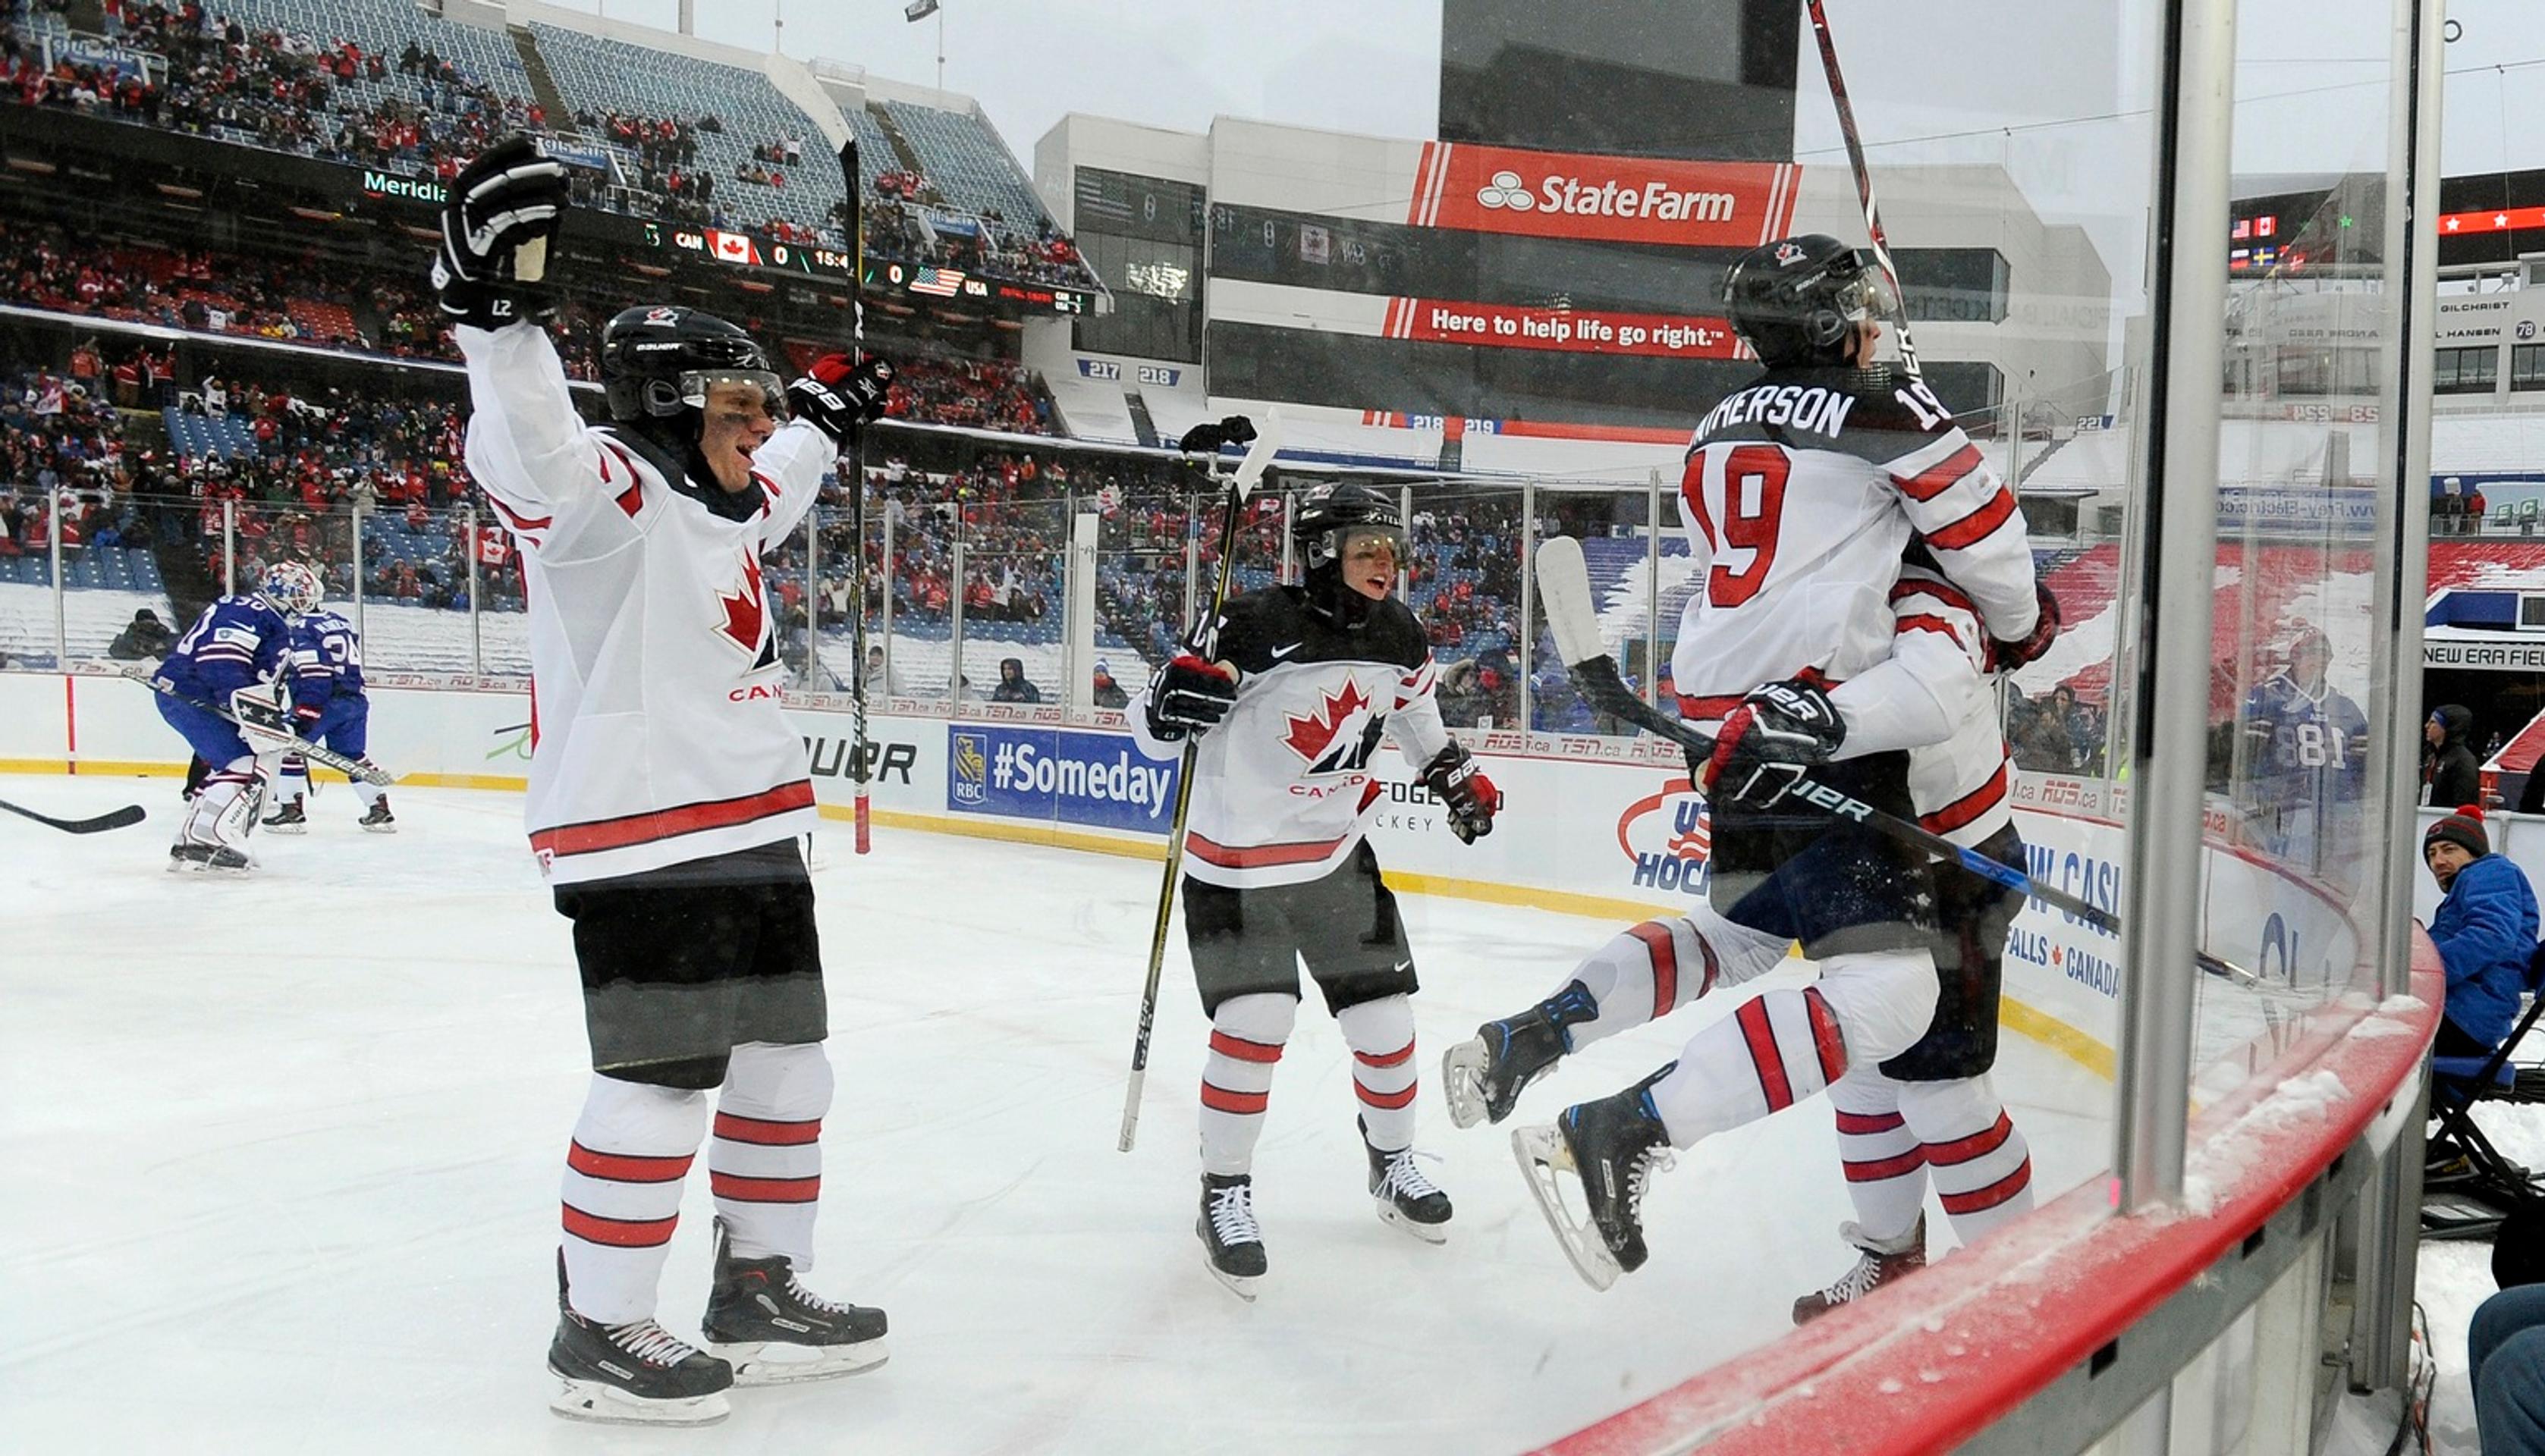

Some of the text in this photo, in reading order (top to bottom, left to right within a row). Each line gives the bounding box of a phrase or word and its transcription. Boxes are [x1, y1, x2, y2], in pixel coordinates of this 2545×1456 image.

[676, 233, 702, 250] CAN
[774, 246, 788, 264] 0
[889, 265, 903, 284] 0
[965, 280, 988, 296] USA
[1431, 309, 1486, 333] Here
[1493, 315, 1517, 335] to
[1522, 316, 1571, 343] help
[1577, 319, 1613, 341] life
[1619, 326, 1646, 346] go
[2518, 323, 2534, 336] 78
[1089, 362, 1120, 378] 217
[1139, 367, 1170, 384] 218
[1412, 416, 1443, 431] 218
[1464, 419, 1494, 434] 219
[1682, 444, 1792, 608] 19
[2423, 648, 2462, 664] NEW
[2465, 648, 2505, 664] ERA
[1560, 738, 1620, 758] TSN.ca
[803, 736, 917, 784] UER
[993, 742, 1170, 819] #Someday
[956, 783, 982, 799] RBC
